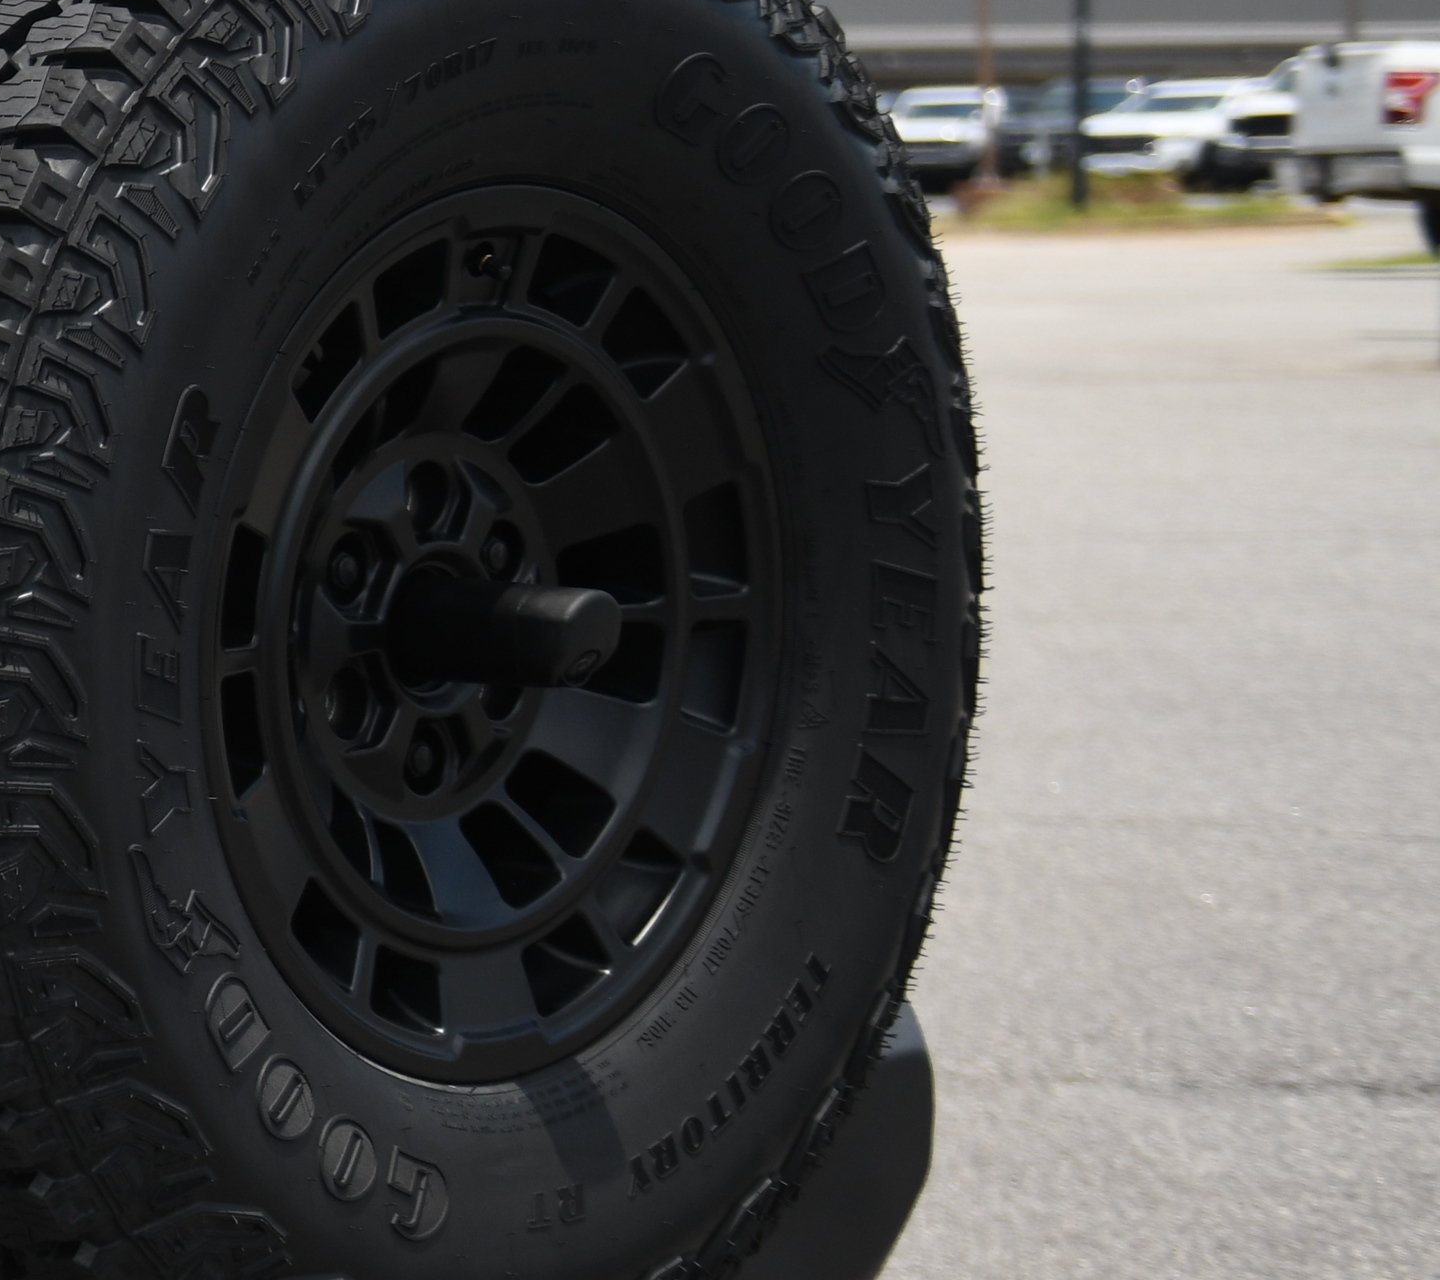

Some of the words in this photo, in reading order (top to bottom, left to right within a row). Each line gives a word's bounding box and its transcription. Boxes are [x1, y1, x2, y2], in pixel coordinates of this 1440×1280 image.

[133, 383, 451, 1242] GOODYEAR
[627, 951, 833, 1200] TERRITORY
[526, 1183, 586, 1231] RT
